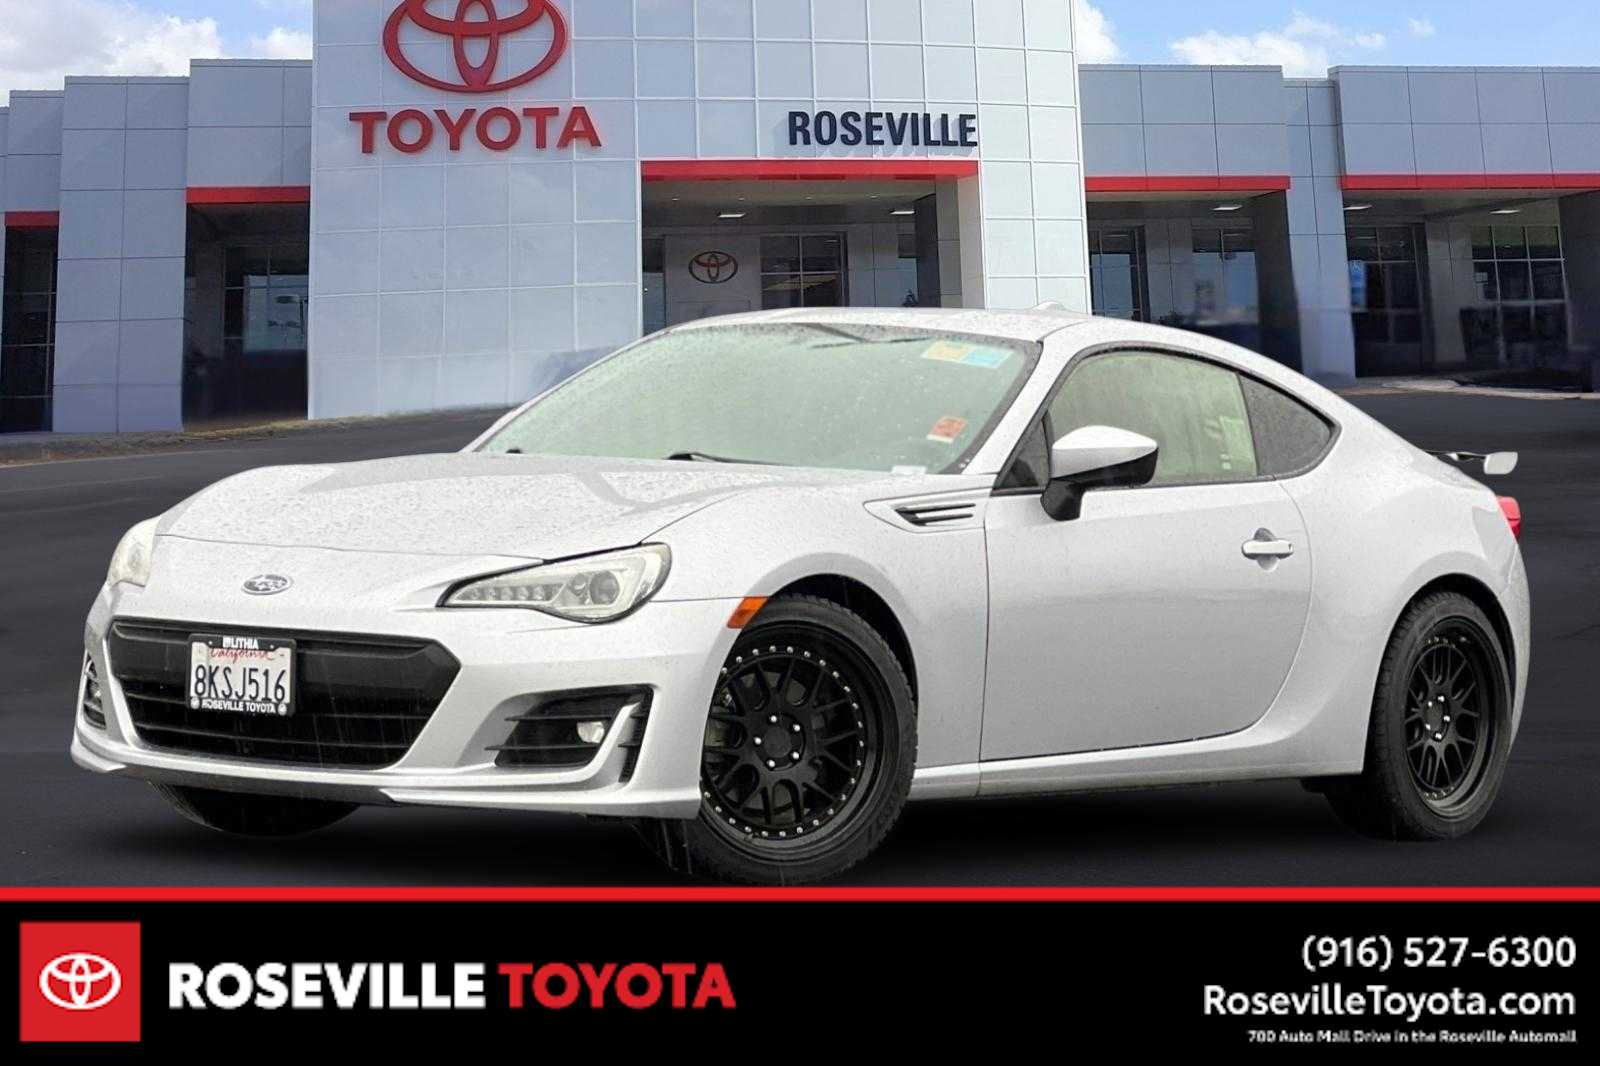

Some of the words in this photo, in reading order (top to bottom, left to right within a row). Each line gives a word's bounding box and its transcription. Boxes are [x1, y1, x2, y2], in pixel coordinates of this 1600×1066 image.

[349, 105, 602, 154] TOYOTA
[788, 110, 978, 148] ROSEVILLE
[194, 664, 286, 703] 8KSJ516
[201, 698, 244, 712] ROSEVILLE
[246, 702, 276, 714] TOYOTA
